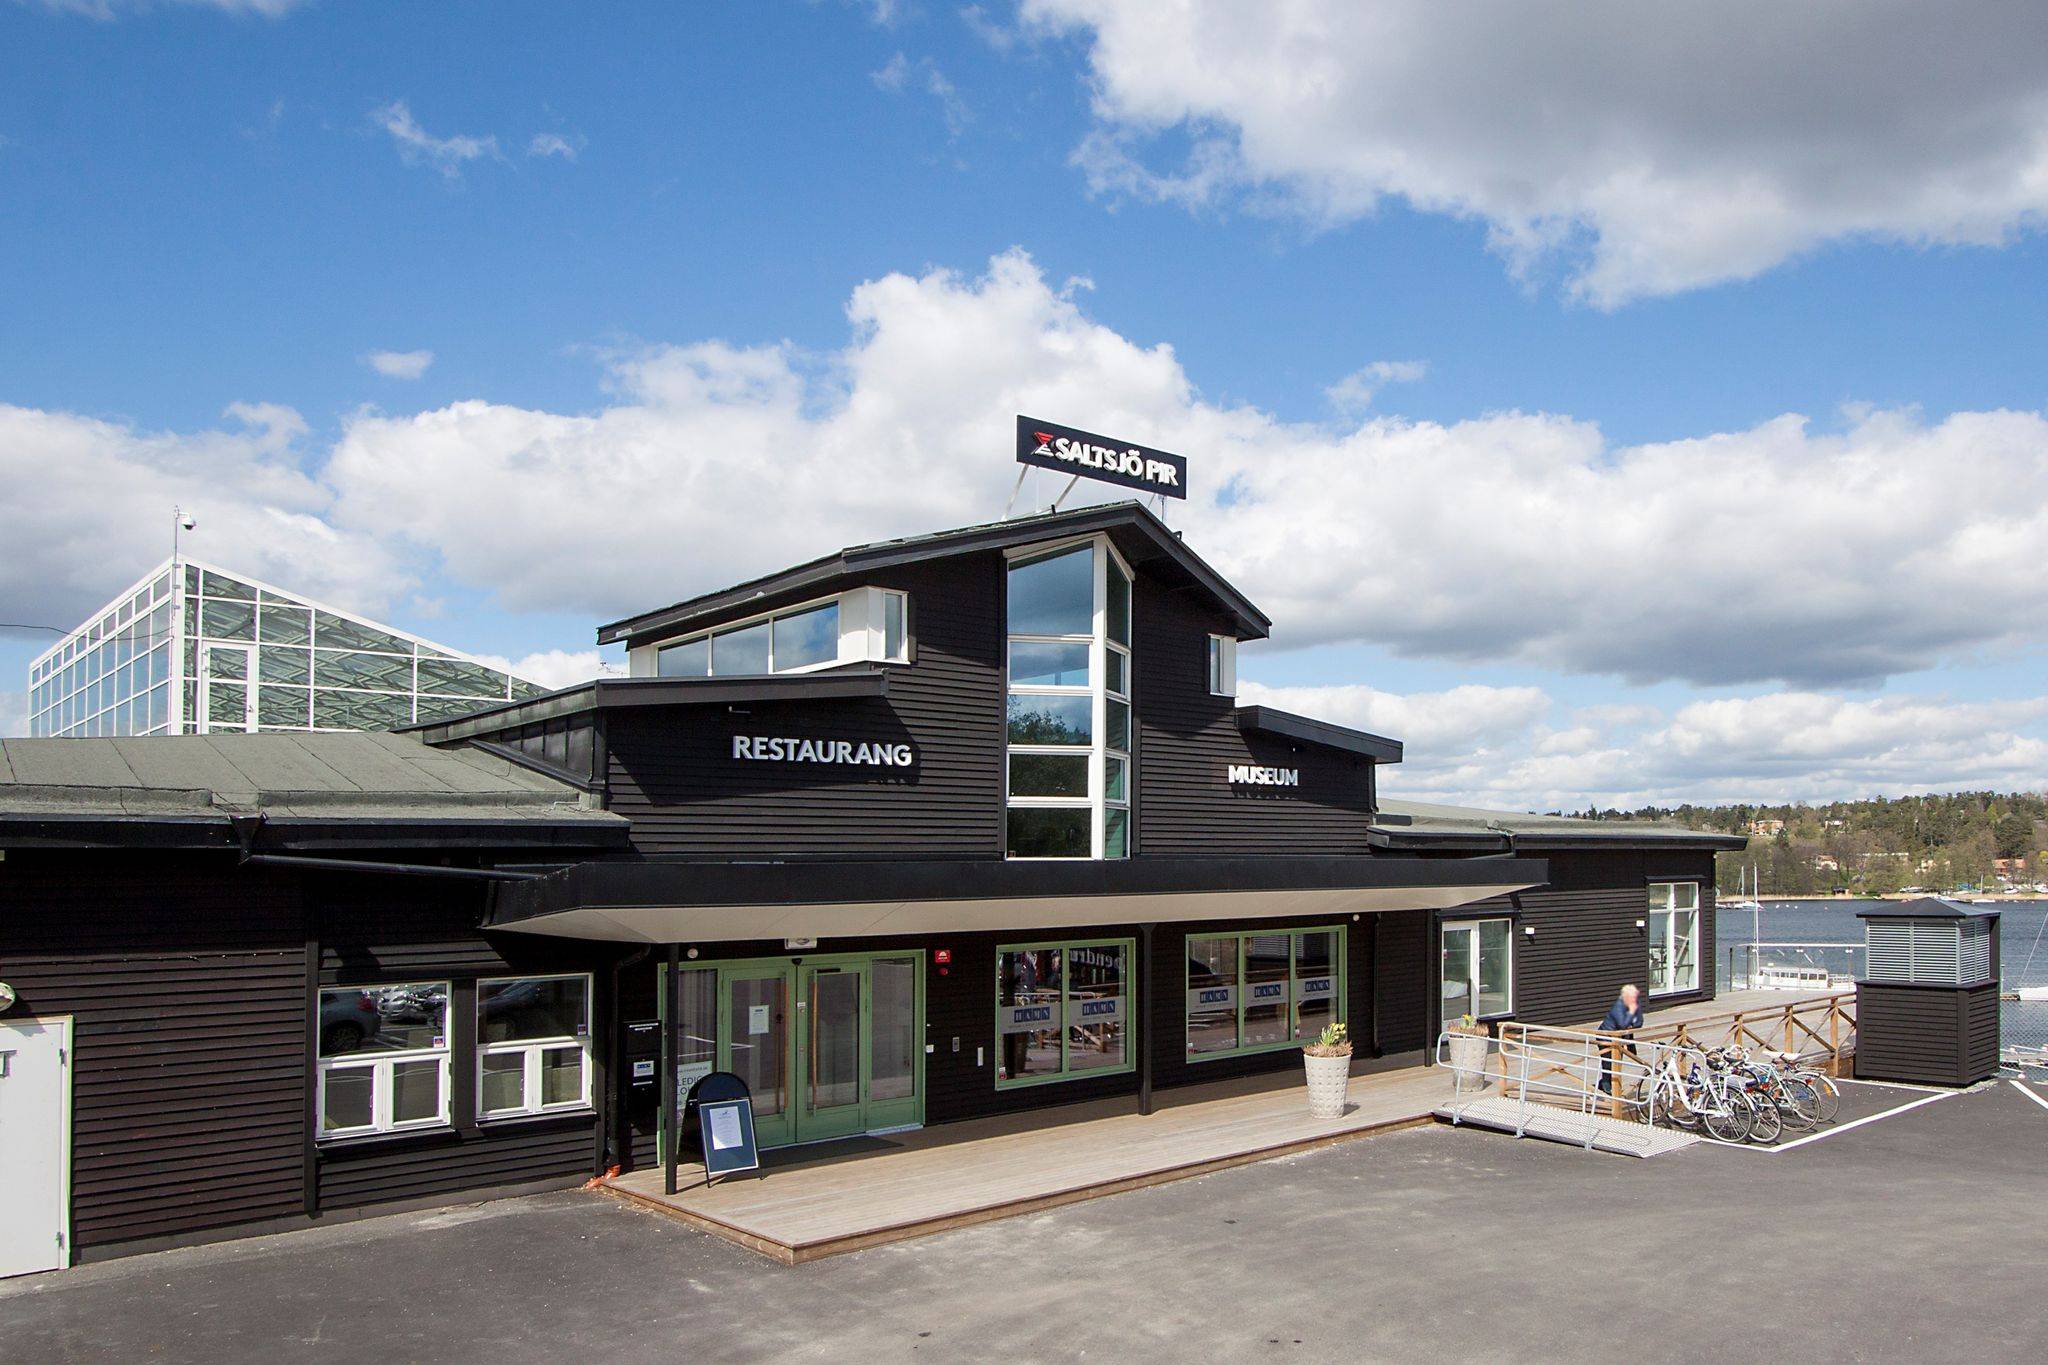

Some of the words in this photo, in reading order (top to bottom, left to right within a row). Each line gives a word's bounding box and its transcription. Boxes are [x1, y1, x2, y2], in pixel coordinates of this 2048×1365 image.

[1055, 437, 1143, 477] SALTSJÖ
[1146, 459, 1179, 486] PIR
[732, 735, 913, 767] RESTAURANG
[1228, 765, 1298, 786] MUSEUM
